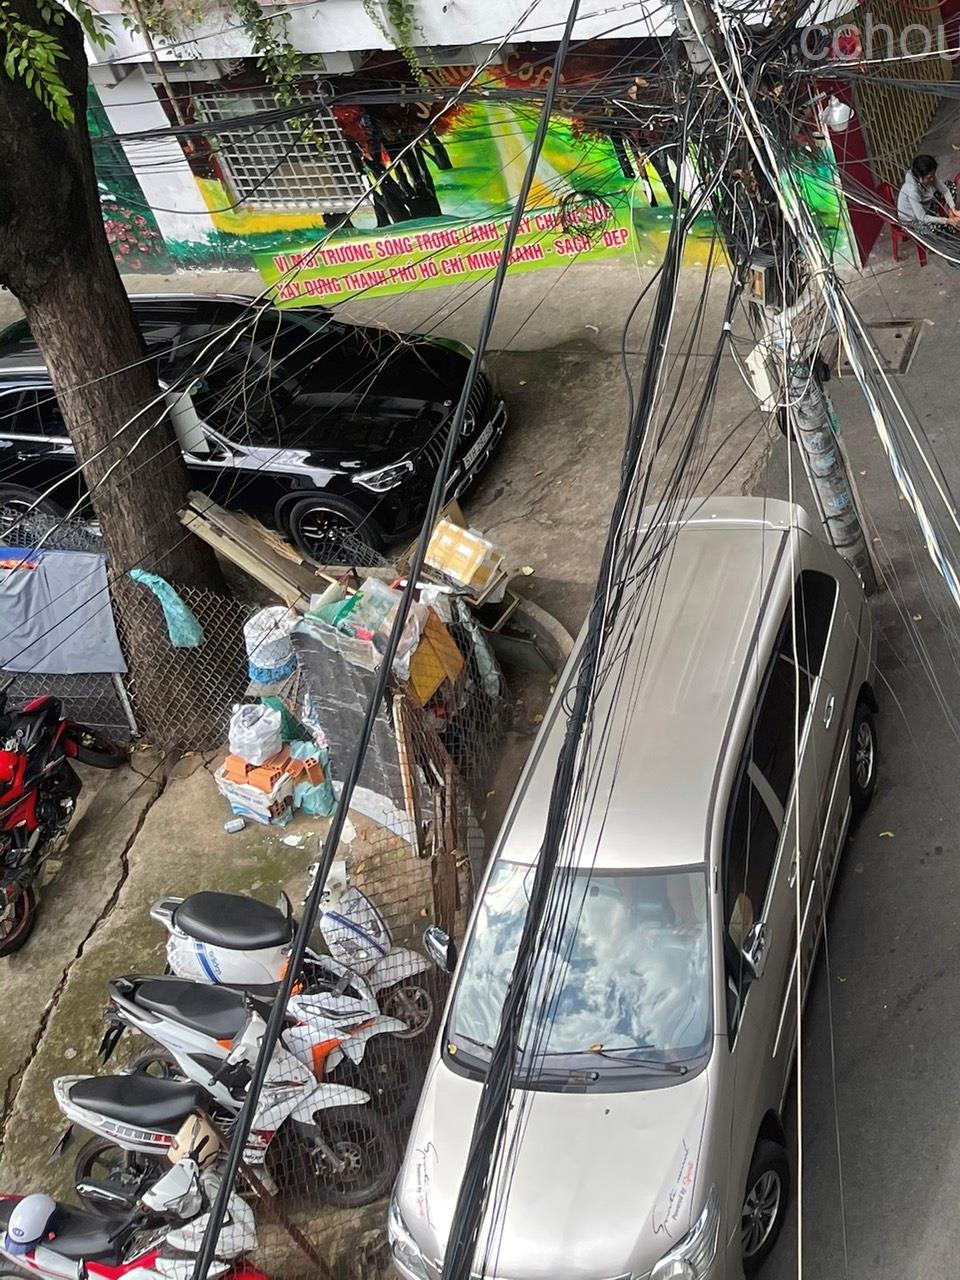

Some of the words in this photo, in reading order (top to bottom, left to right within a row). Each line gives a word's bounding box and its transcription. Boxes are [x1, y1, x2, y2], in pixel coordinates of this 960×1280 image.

[304, 277, 342, 299] DỰNG
[343, 269, 389, 291] THÀNH
[390, 261, 417, 283] PHỐ
[418, 255, 439, 279] HỒ
[440, 253, 465, 276] CHÍ
[466, 250, 502, 272] MINH
[554, 234, 592, 258] SẠCH
[602, 228, 631, 250] ĐẸP
[320, 241, 374, 266] TRƯỜNG
[375, 233, 412, 258] SỐNG
[414, 228, 460, 250] TRONG
